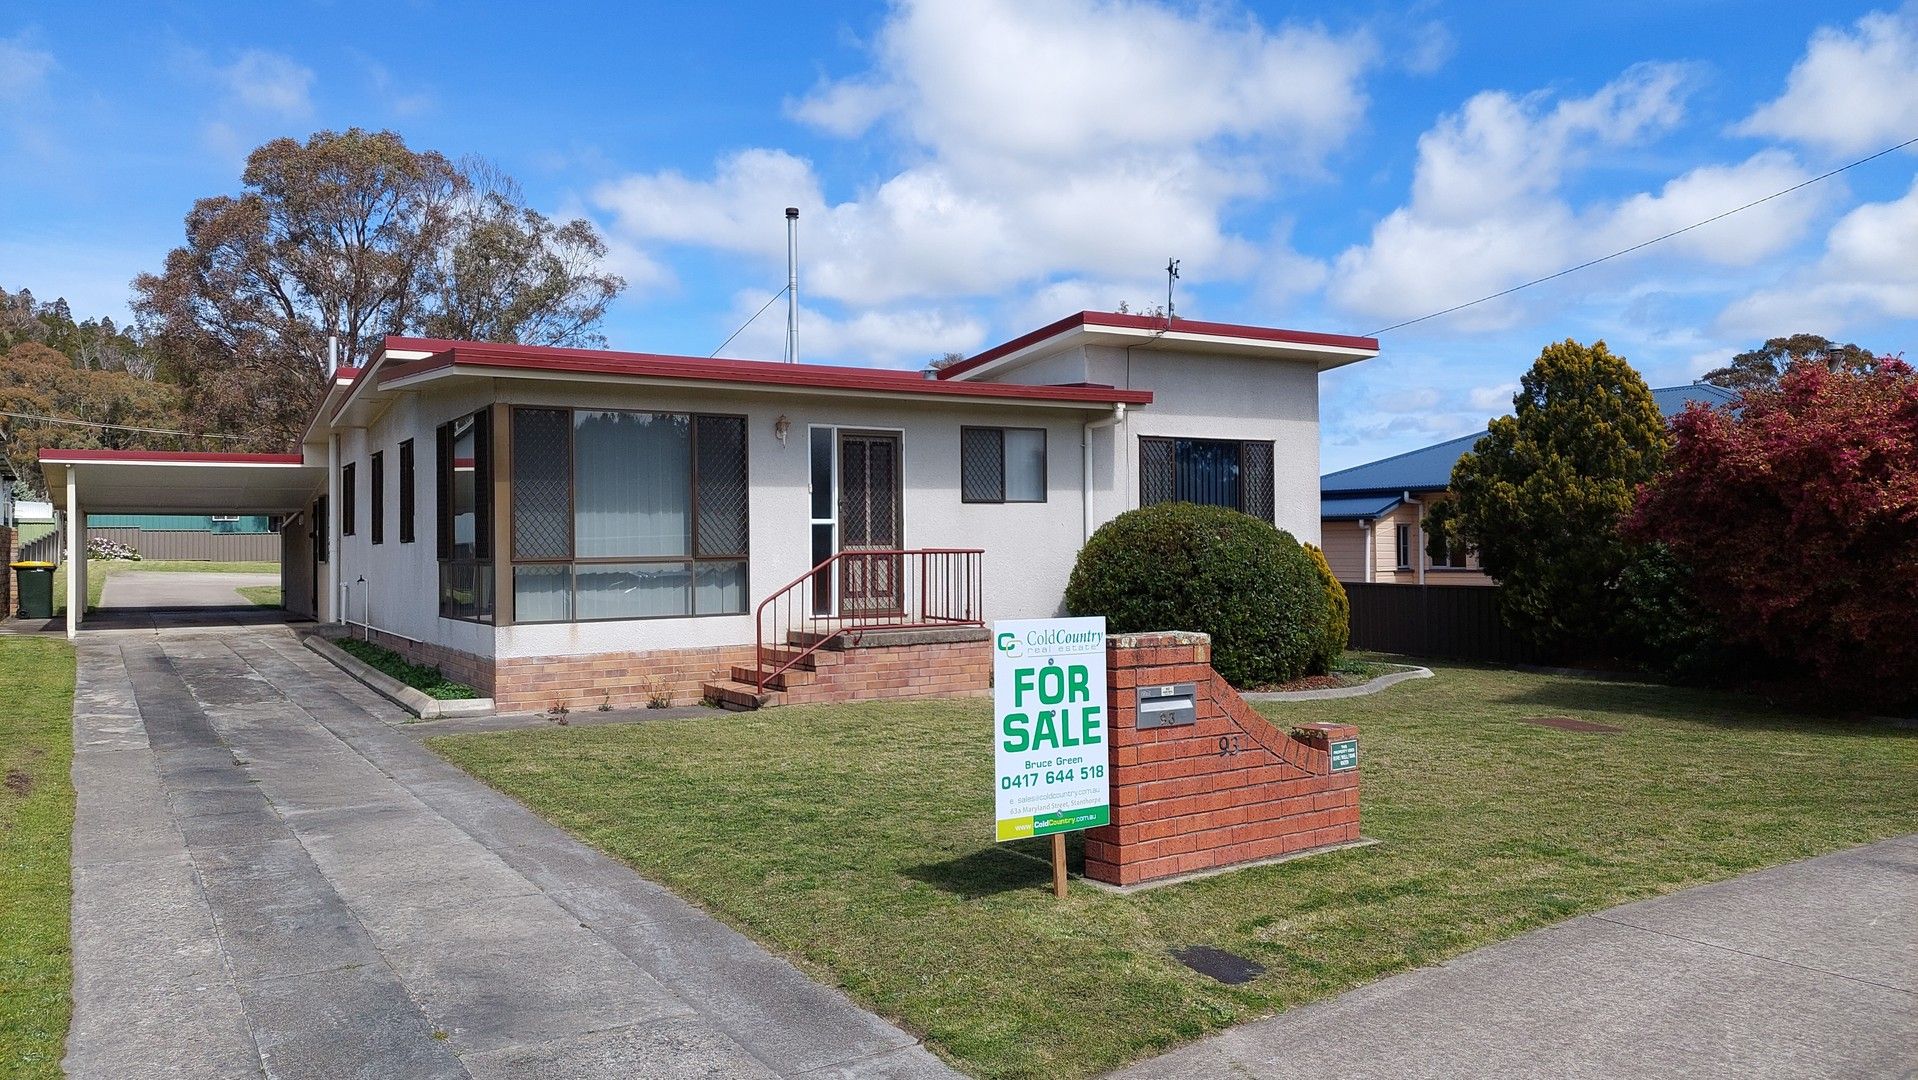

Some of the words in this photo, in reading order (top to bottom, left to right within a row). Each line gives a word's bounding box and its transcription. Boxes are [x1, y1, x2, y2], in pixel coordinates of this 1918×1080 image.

[1027, 629, 1103, 646] ColdCountry
[1028, 645, 1052, 654] real
[1058, 644, 1097, 652] estate
[1015, 665, 1089, 707] FOR
[1003, 706, 1101, 752] SALE
[1219, 736, 1239, 756] 93
[1025, 760, 1052, 769] Bruce
[1056, 757, 1083, 766] Green
[1002, 773, 1039, 789] 0417
[1046, 769, 1074, 784] 644
[1080, 765, 1104, 780] 518
